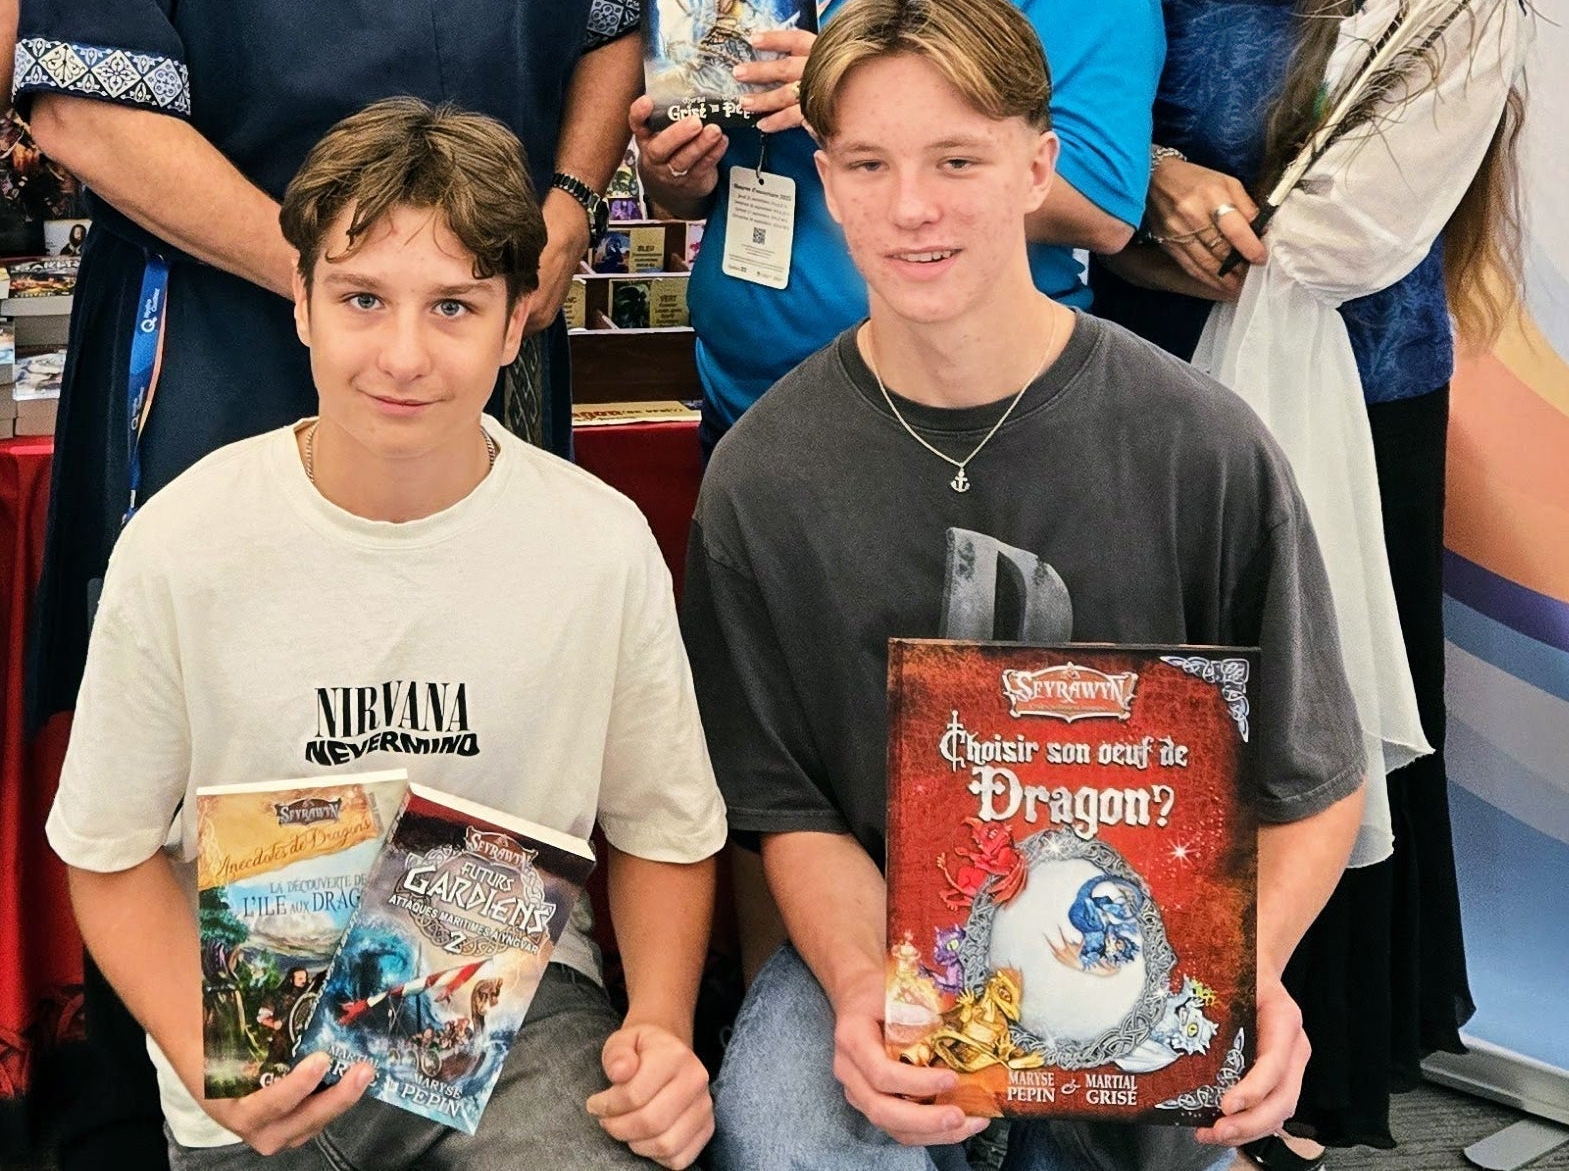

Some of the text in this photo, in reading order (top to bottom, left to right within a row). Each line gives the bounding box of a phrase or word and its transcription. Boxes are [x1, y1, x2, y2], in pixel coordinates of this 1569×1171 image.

[1012, 672, 1131, 710] SEYRAWYN
[315, 680, 470, 738] NIRVANA
[305, 731, 480, 766] NEVERMIND
[939, 710, 1188, 772] Choisir son oeuf de
[280, 802, 341, 823] SEYRAWYN
[967, 766, 1175, 840] Dragon?
[216, 821, 371, 878] Anecdotes de Dragons
[469, 833, 533, 870] SEYRAWYN
[270, 882, 284, 894] LA
[354, 874, 367, 887] DE
[461, 861, 515, 892] FUTURS
[290, 901, 310, 914] AUX
[313, 888, 361, 912] DRAG
[388, 894, 438, 918] ATTAQUES
[439, 911, 490, 936] MARITIMES
[403, 865, 551, 934] GARDIENS
[444, 930, 467, 954] 2
[414, 1073, 464, 1100] MARYSE
[1007, 1087, 1055, 1102] PEPIN
[1008, 1071, 1055, 1086] MARYSE
[1085, 1073, 1137, 1089] MARTIAL
[402, 1084, 461, 1117] PEPIN
